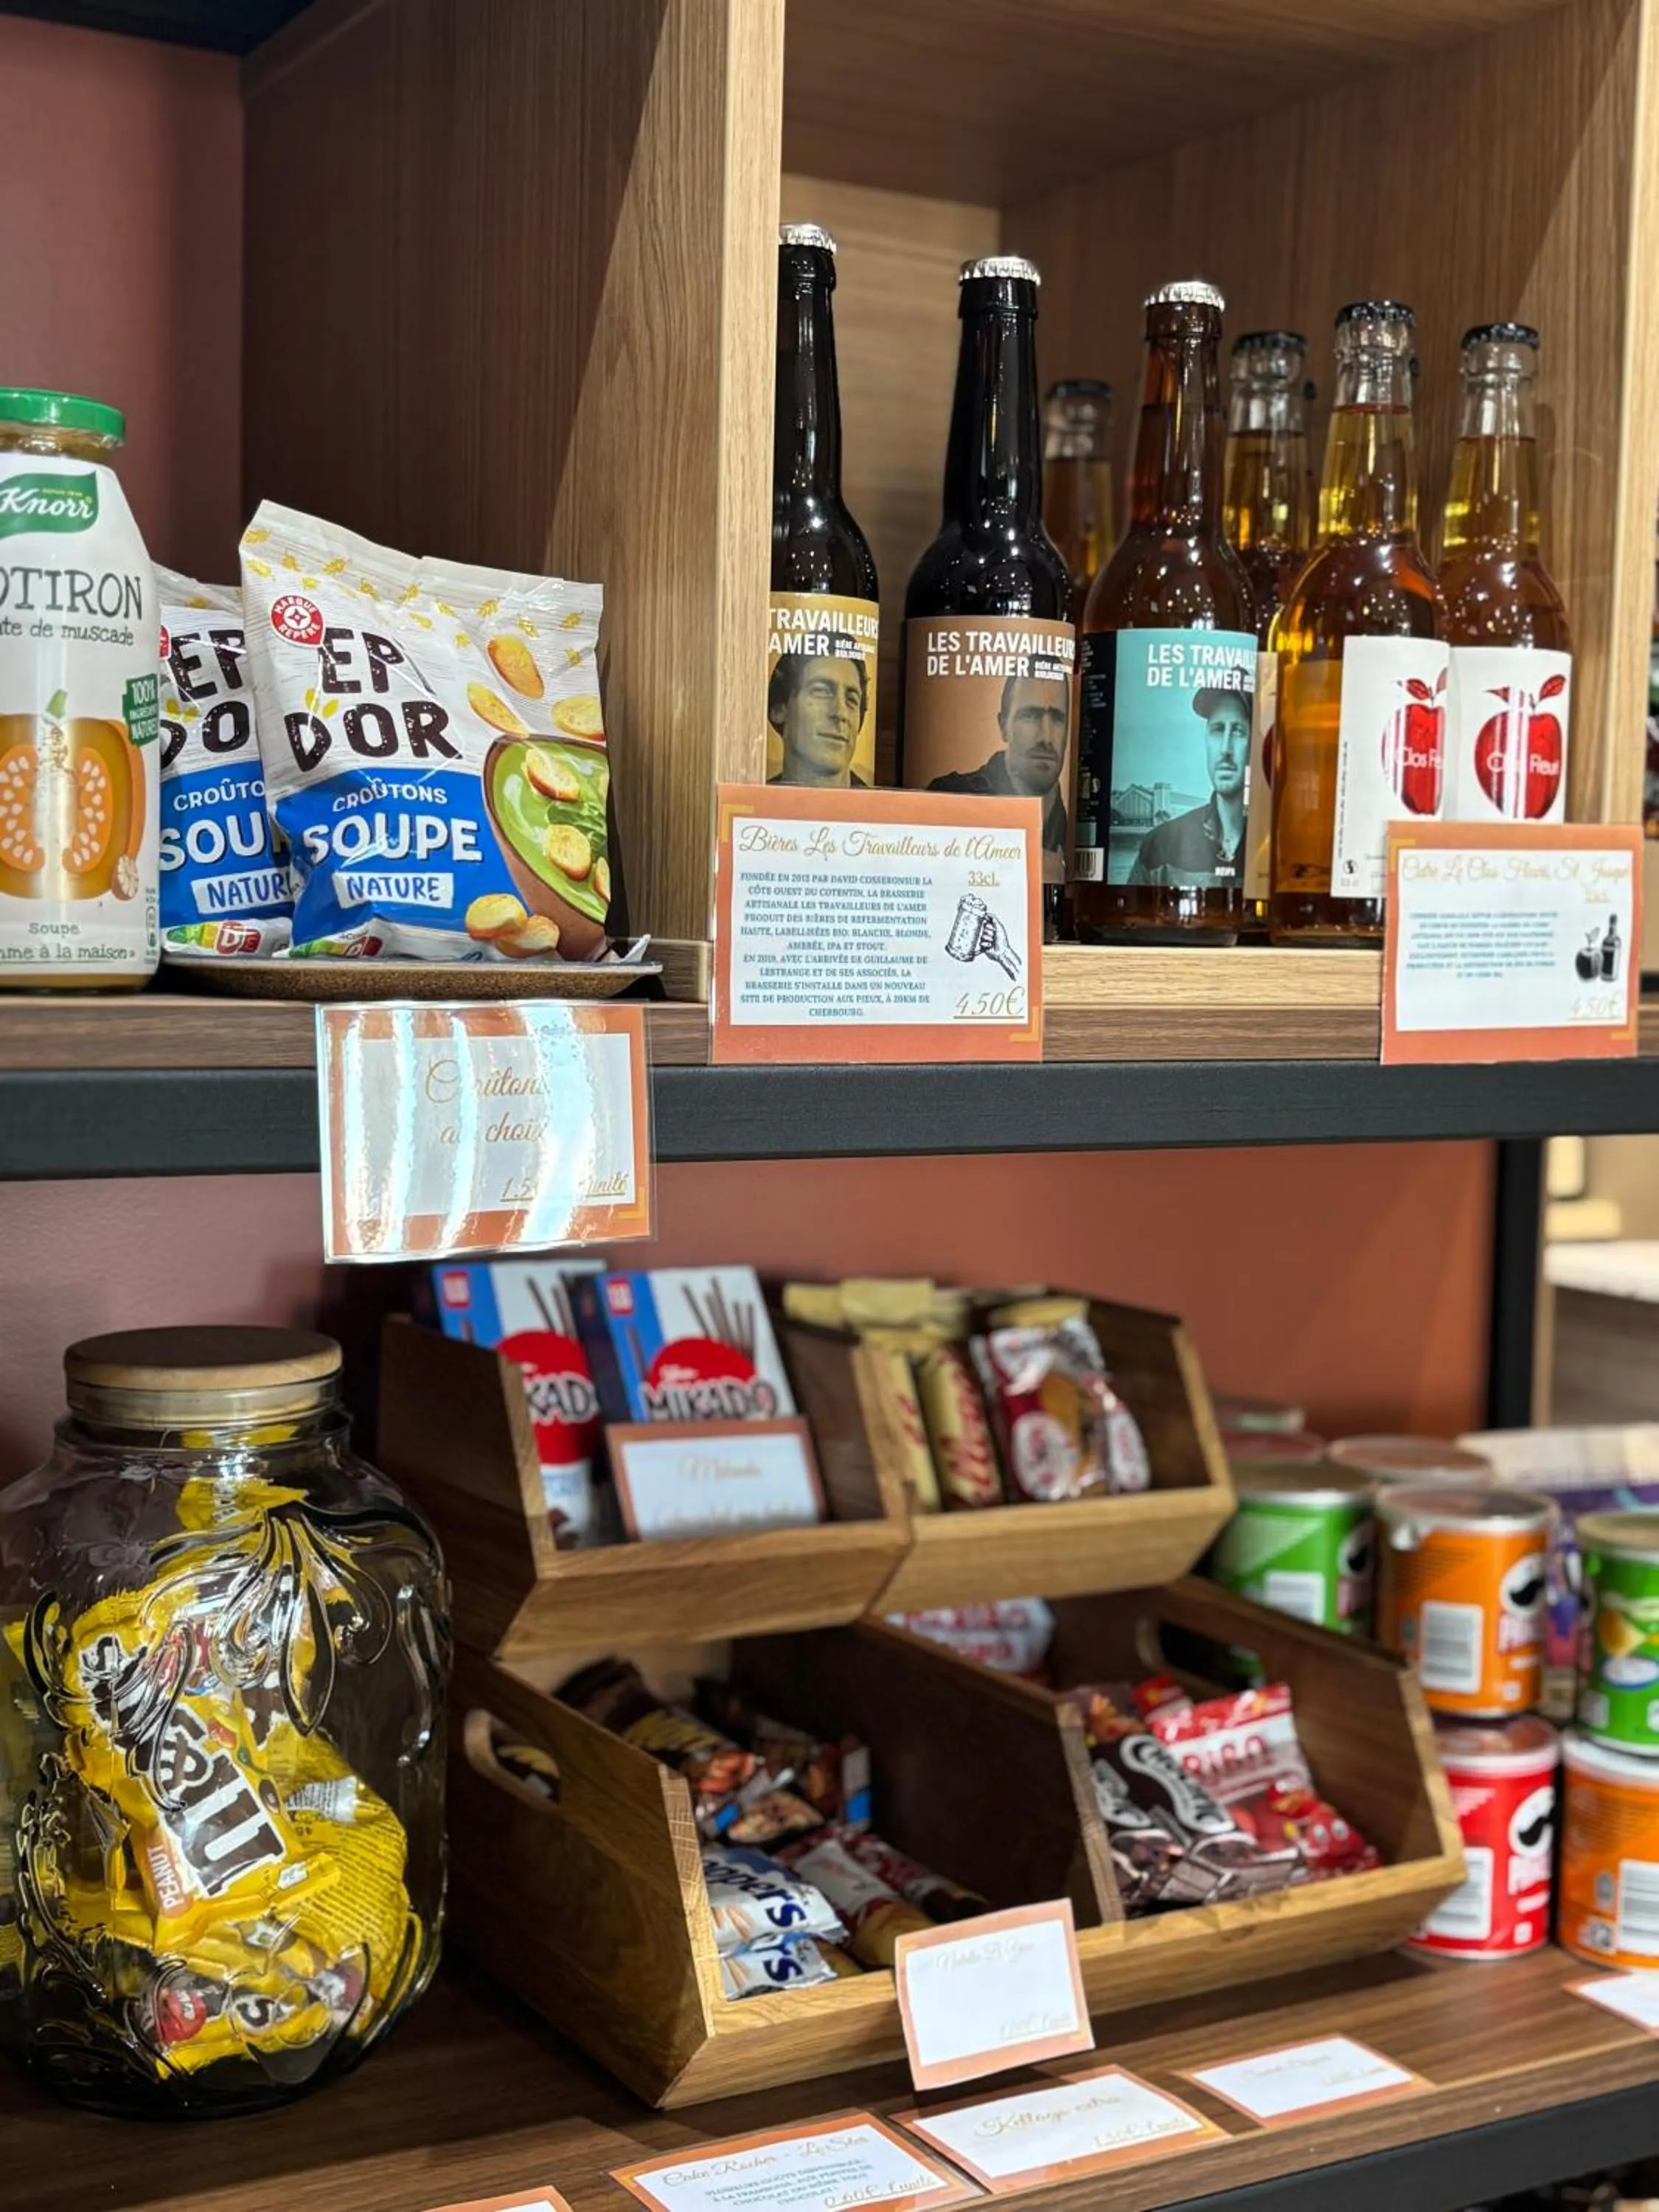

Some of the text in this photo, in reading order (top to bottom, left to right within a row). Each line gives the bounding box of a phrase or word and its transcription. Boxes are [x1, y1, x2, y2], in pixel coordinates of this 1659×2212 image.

[0, 487, 94, 518] Knorr
[30, 618, 54, 639] de
[61, 625, 134, 647] muscade
[928, 630, 961, 653] LES
[927, 655, 950, 677] DE
[956, 654, 1030, 678] L'AMER
[1148, 644, 1185, 666] LES
[1147, 667, 1174, 687] DE
[1179, 667, 1242, 691] L'AMER
[333, 778, 448, 812] CROÛTONS
[303, 813, 483, 866] SOUPE
[739, 825, 797, 852] Bières
[803, 827, 837, 860] Les
[843, 831, 939, 857] Travailleurs
[944, 838, 961, 858] de
[207, 873, 291, 908] NATUR
[347, 874, 441, 902] NATURE
[777, 873, 789, 882] EN
[812, 874, 829, 883] PAR
[831, 874, 858, 884] DAVID
[922, 876, 933, 886] LA
[748, 885, 772, 895] CÔTE
[774, 887, 801, 896] OUEST
[804, 887, 818, 896] DU
[868, 889, 878, 897] LA
[880, 889, 925, 899] BRASSERIE
[745, 900, 927, 912] ARTISANALE LES TRAVAILLEURS DE L'AMER
[745, 914, 784, 922] PRODUIT
[787, 914, 802, 923] DES
[838, 915, 849, 924] DE
[28, 922, 81, 939] Soupe
[39, 943, 50, 960] à
[57, 944, 72, 959] la
[78, 945, 128, 960] maison
[827, 942, 841, 951] IPA
[844, 942, 854, 951] ET
[743, 954, 756, 963] EN
[780, 954, 803, 964] AVEC
[805, 953, 849, 964] L'ARRIVÉE
[851, 955, 862, 964] DE
[864, 955, 914, 965] GUILLAUME
[917, 956, 928, 965] DE
[813, 967, 824, 978] ET
[825, 967, 837, 978] DE
[839, 968, 854, 978] SES
[901, 968, 911, 978] LA
[745, 981, 925, 991] BRASSERIE S'INSTALLE DANS UN NOUVEAU
[740, 994, 760, 1004] SITE
[762, 994, 775, 1004] DE
[776, 994, 834, 1004] PRODUCTION
[836, 995, 854, 1004] AUX
[918, 995, 930, 1005] DE
[147, 1843, 186, 1909] PEANUT
